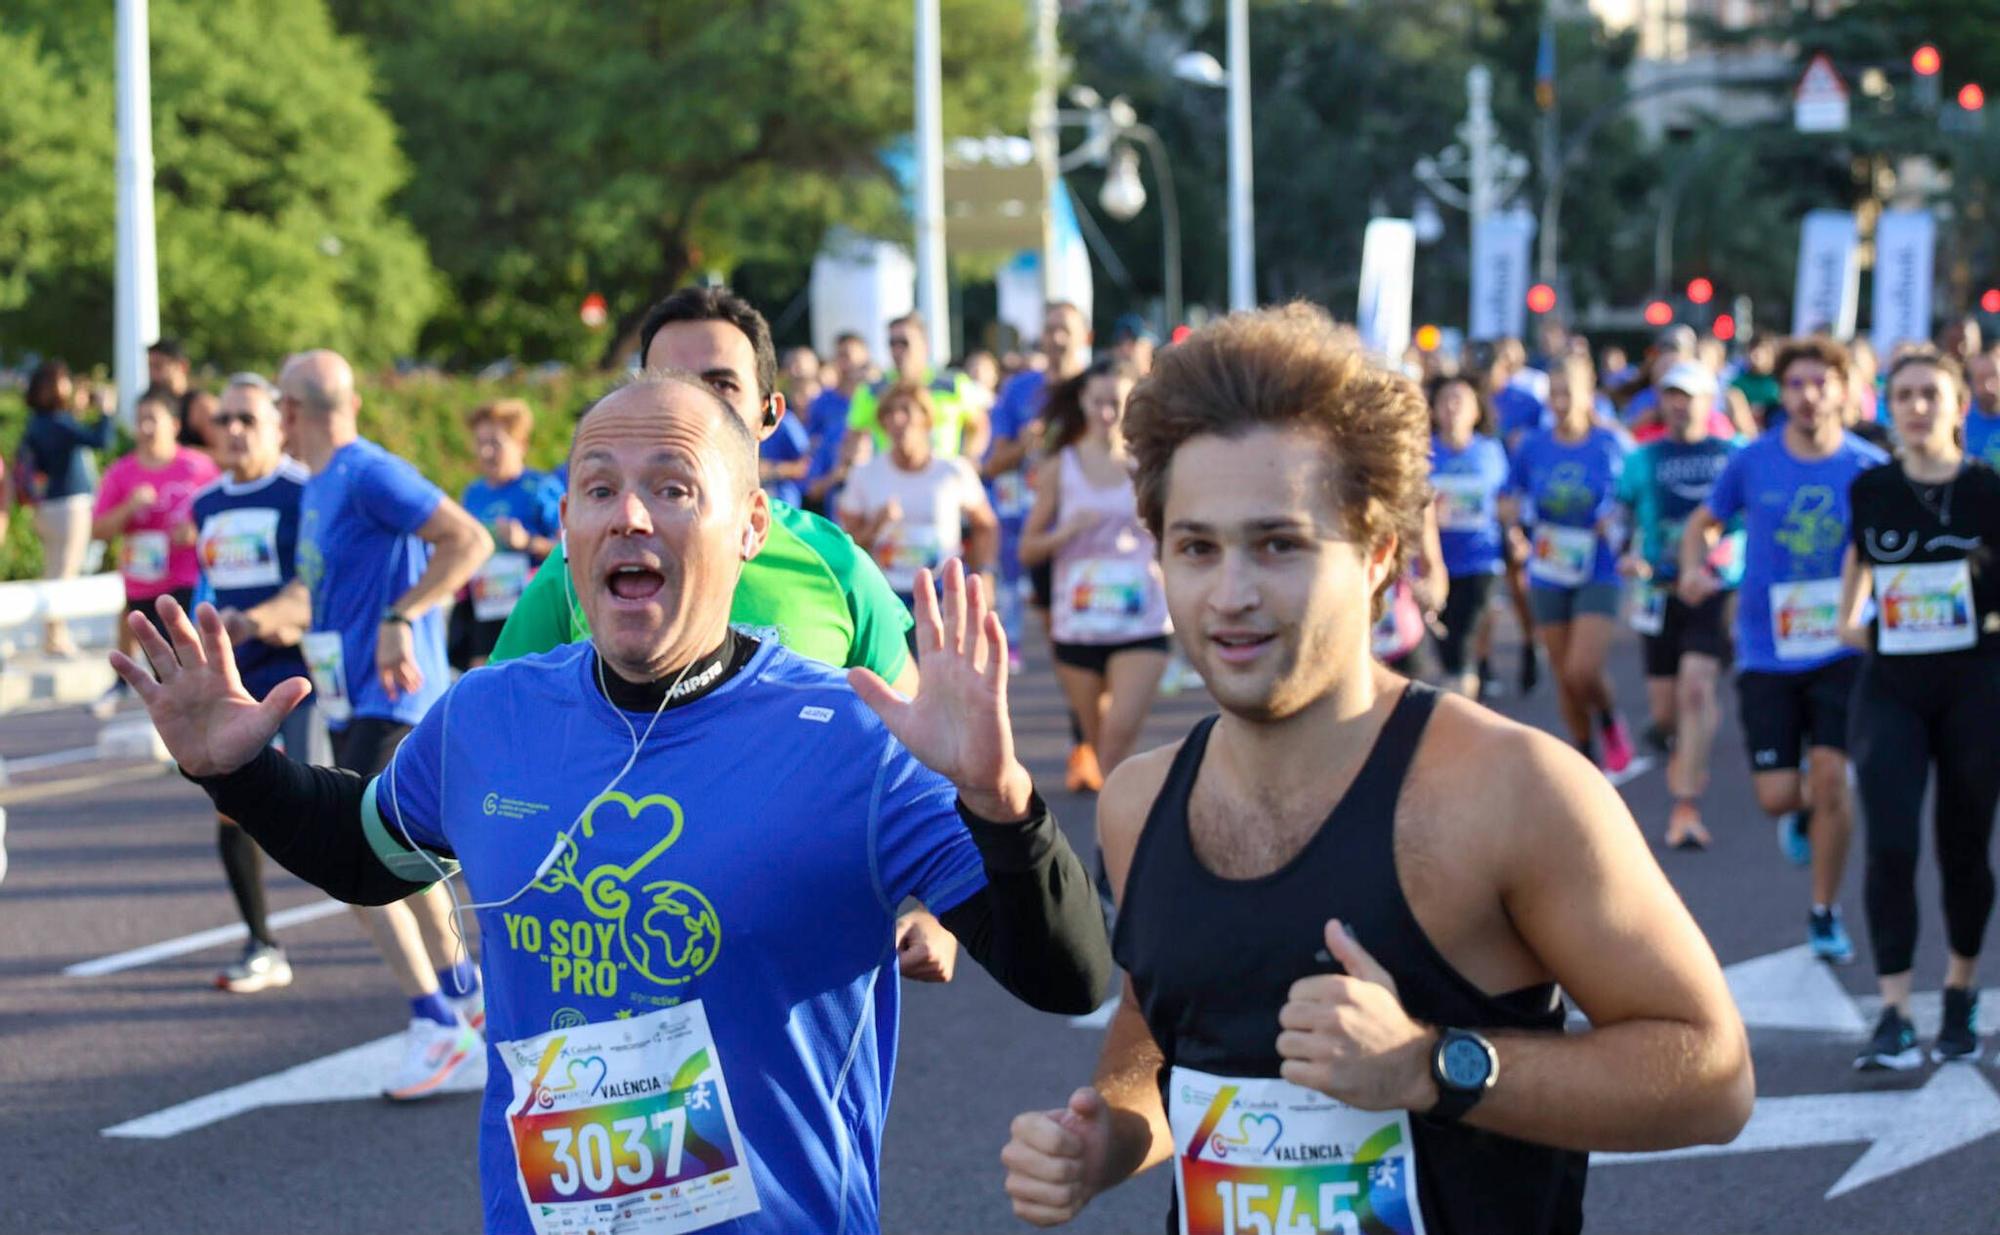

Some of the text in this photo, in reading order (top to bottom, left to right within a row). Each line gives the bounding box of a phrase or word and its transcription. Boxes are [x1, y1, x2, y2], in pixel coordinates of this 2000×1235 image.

[504, 912, 616, 960] YO SOY
[543, 1106, 687, 1196] 3037
[1216, 1181, 1360, 1235] 1545
